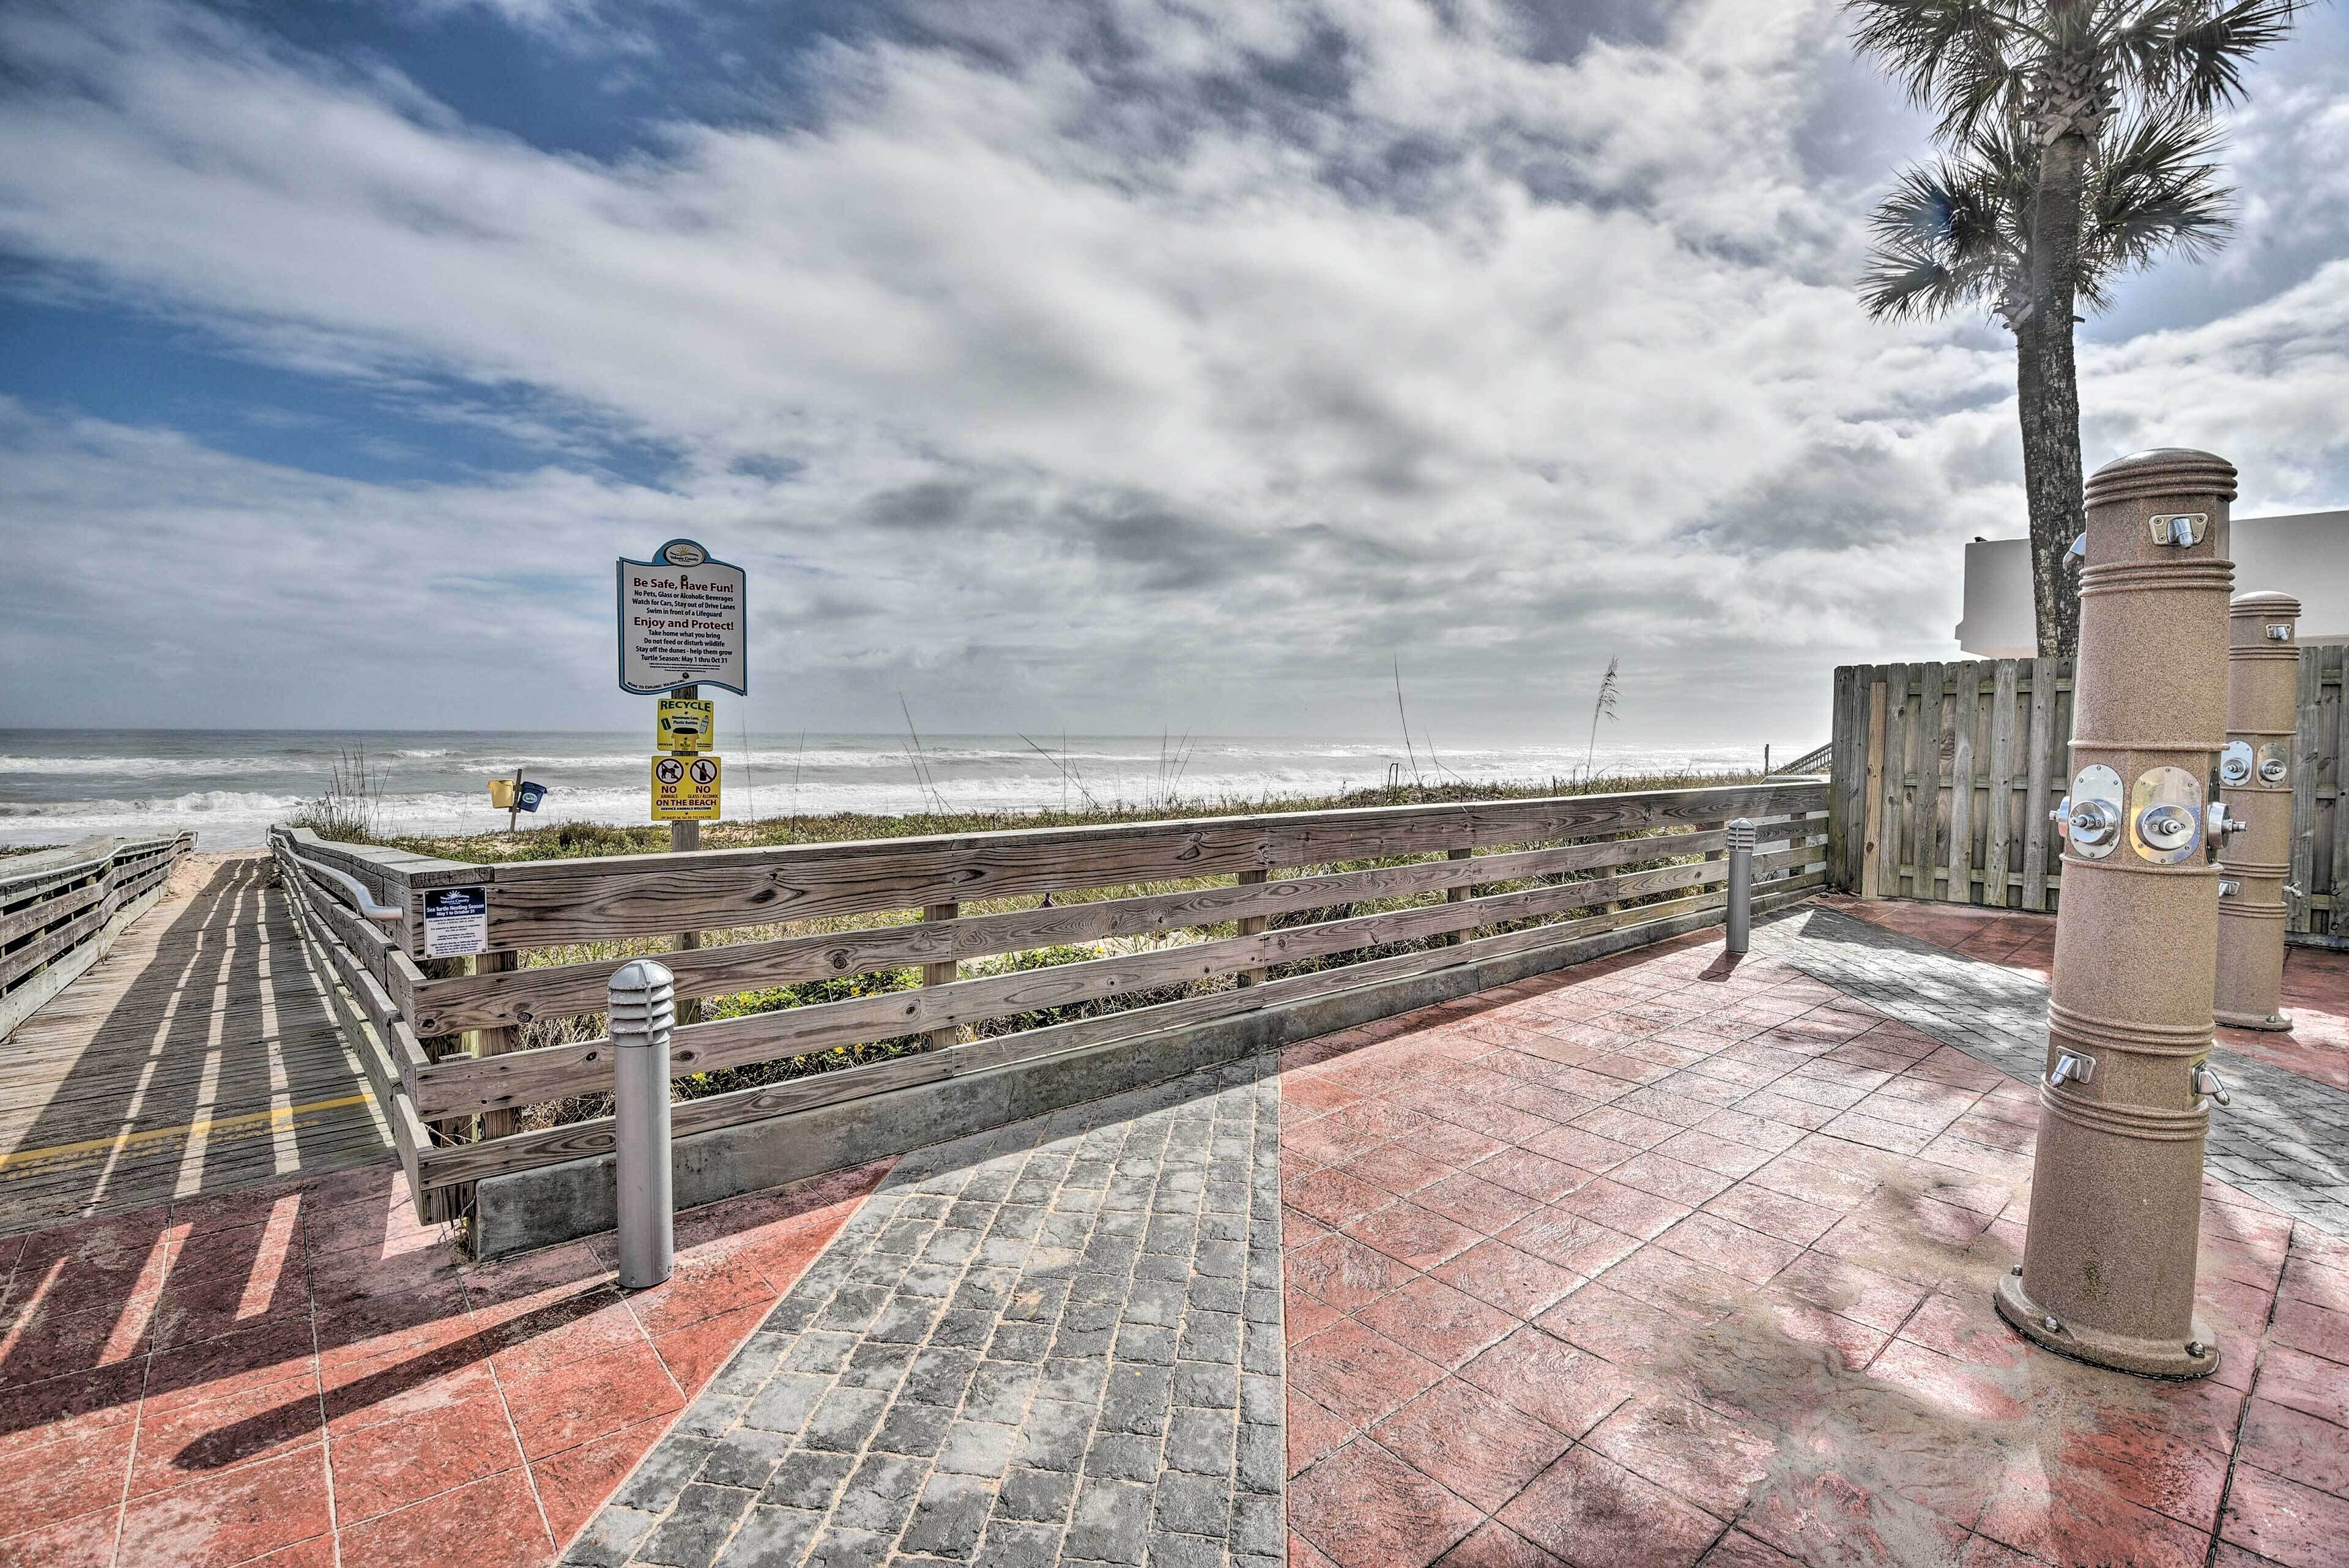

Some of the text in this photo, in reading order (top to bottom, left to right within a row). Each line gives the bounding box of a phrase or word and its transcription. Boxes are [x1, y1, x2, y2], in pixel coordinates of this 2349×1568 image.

[634, 578, 733, 593] Be Safe, Have Fun!
[705, 594, 733, 603] Beverages
[634, 616, 734, 631] Enjoy and Protect!
[660, 700, 711, 713] RECYCLE
